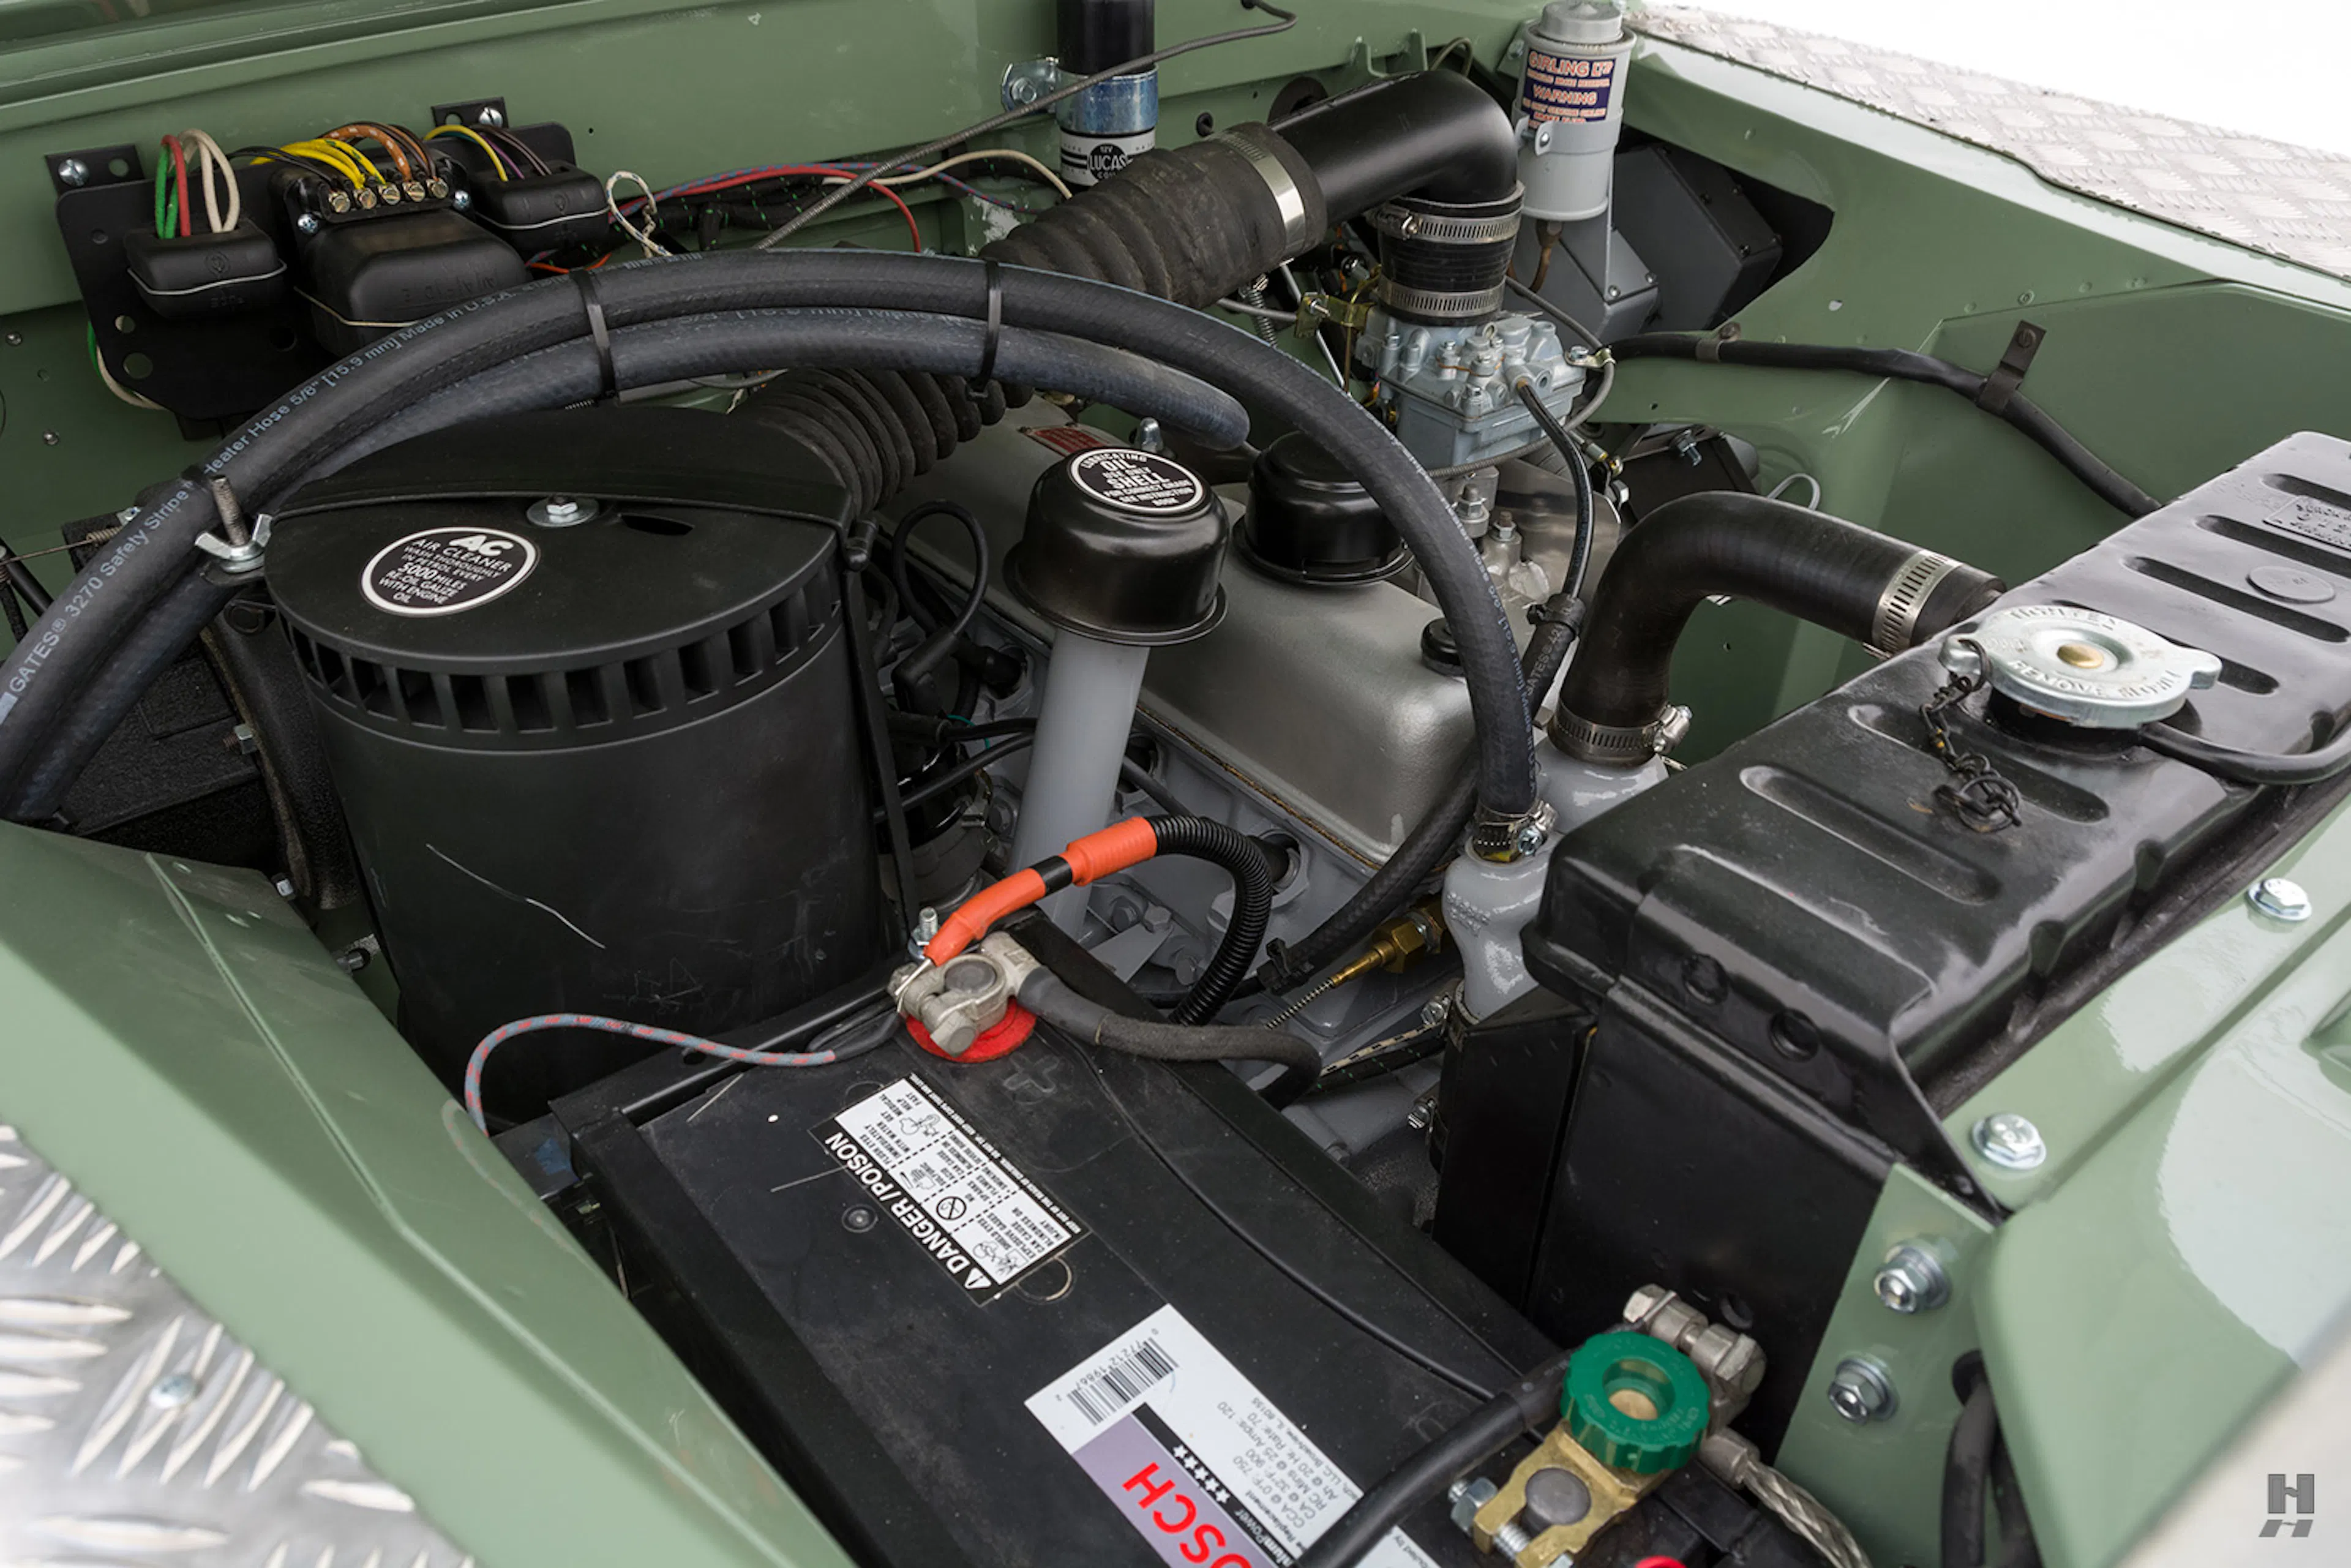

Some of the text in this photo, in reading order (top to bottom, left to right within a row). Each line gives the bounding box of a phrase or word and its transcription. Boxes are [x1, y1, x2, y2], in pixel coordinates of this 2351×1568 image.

[1529, 51, 1590, 77] GIRLING
[1533, 83, 1597, 105] WARNING
[1090, 154, 1128, 170] LUCAS
[64, 575, 104, 618] 3270
[99, 528, 151, 579] Safety
[246, 403, 291, 438] Hose
[321, 355, 364, 388] [15.9
[364, 335, 402, 362] mm]
[399, 314, 444, 343] Made
[445, 306, 463, 320] in
[465, 285, 517, 319] U.S.A.
[1081, 453, 1147, 468] LUBRICATING
[1100, 459, 1137, 471] OIL
[1107, 473, 1171, 489] SHELL
[403, 546, 501, 578] WASH THOROUGHLY
[412, 539, 512, 572] AIR CLEANER
[401, 553, 485, 582] IN PETROL EVERY
[378, 578, 449, 604] WITH ENGINE
[420, 580, 459, 597] GAUZE
[433, 574, 468, 590] MILES
[392, 592, 411, 603] OIL
[879, 1093, 903, 1116] MEDICAL
[896, 1098, 912, 1111] HELP
[905, 1092, 921, 1105] FAST
[859, 1134, 876, 1148] EYES
[864, 1124, 900, 1158] IMMEDIATELY
[876, 1121, 910, 1152] WITH WATER
[937, 1150, 964, 1174] CAN CAUSE
[975, 1175, 998, 1195] FLAMES
[982, 1166, 1007, 1189] SMOKING
[967, 1180, 989, 1201] SPARKS
[890, 1198, 970, 1273] DANGER
[977, 1218, 993, 1232] EYES
[1021, 1216, 1054, 1246] BLINDNESS
[1040, 1220, 1062, 1239] INJURY
[1004, 1229, 1036, 1258] EXPLOSIVE
[1011, 1221, 1045, 1252] CAN CAUSE
[1109, 1340, 1143, 1365] 77212
[1075, 1365, 1107, 1390] 19867
[1247, 1411, 1262, 1427] 70
[1262, 1425, 1286, 1450] Rate:
[1215, 1400, 1327, 1511] RC Mins @ 25 Amps: 120
[1232, 1455, 1253, 1475] 750
[1245, 1447, 1265, 1468] 900
[1297, 1461, 1314, 1477] 20
[1311, 1475, 1324, 1487] @
[1269, 1492, 1283, 1505] @
[1288, 1491, 1300, 1502] @
[1321, 1485, 1338, 1501] Ah
[1243, 1490, 1297, 1542] Replacement
[1280, 1502, 1306, 1529] CCA
[1298, 1501, 1316, 1520] CA
